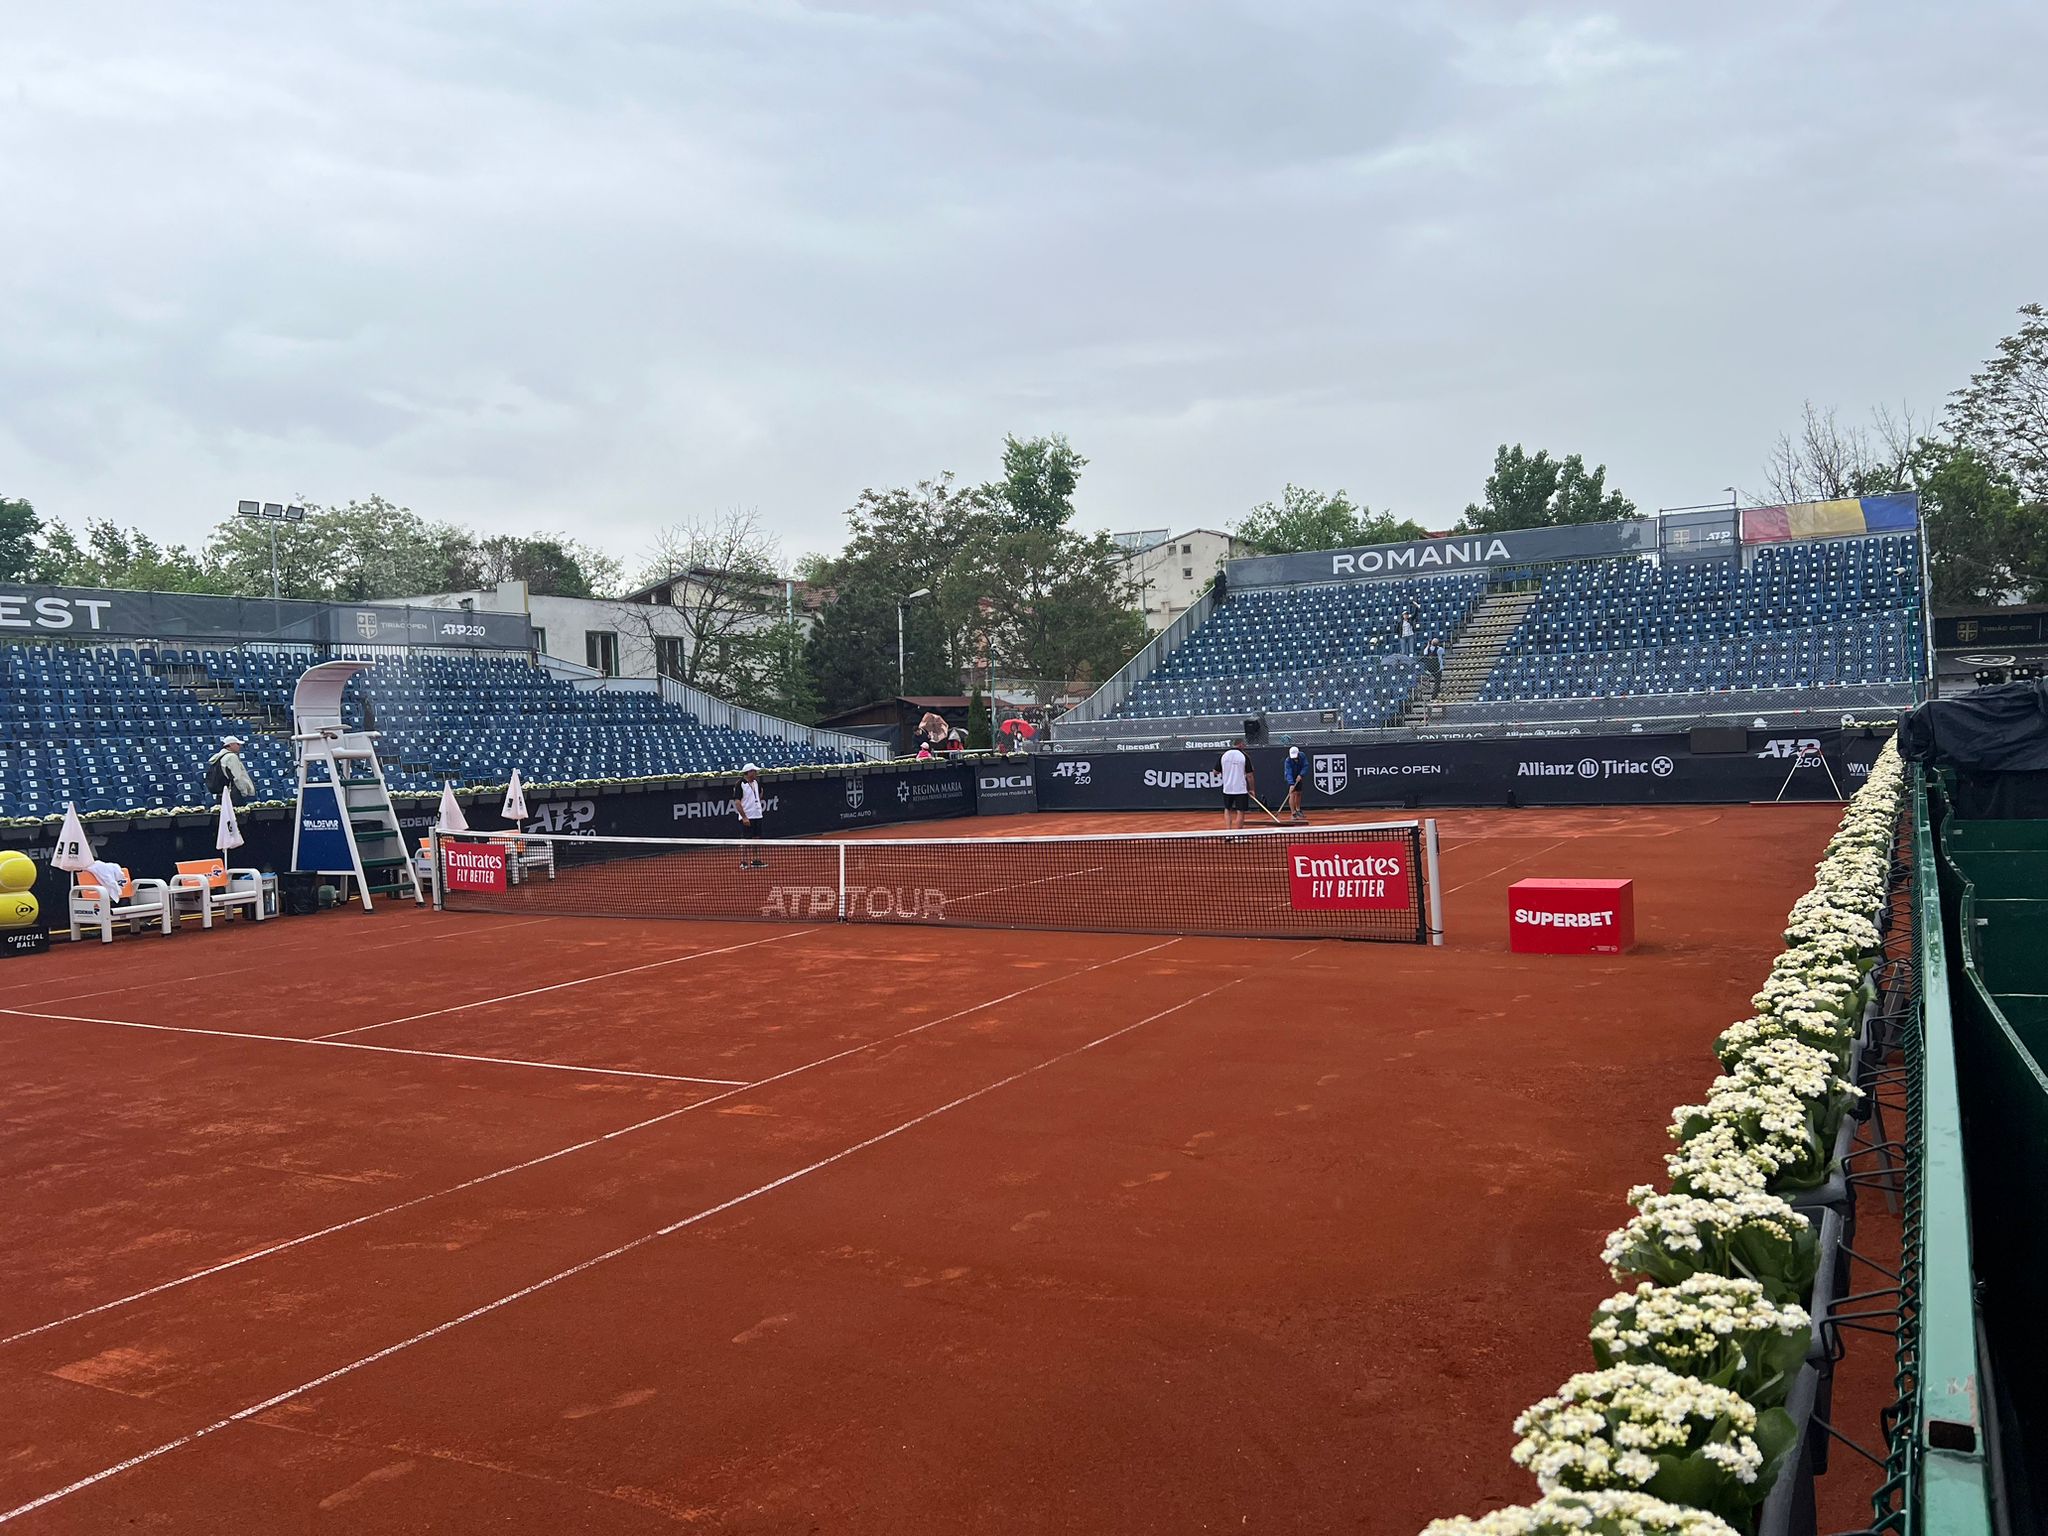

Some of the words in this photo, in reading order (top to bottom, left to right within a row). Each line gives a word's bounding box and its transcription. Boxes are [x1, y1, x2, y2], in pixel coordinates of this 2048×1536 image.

[1333, 539, 1511, 575] ROMANIA
[0, 595, 111, 630] EST
[381, 622, 406, 630] TIRIAC
[1754, 739, 1822, 759] ATP
[1052, 762, 1091, 777] ATP
[1517, 761, 1574, 776] Allianz
[1796, 757, 1822, 768] 250
[1354, 766, 1399, 777] TIRIAC
[1401, 765, 1441, 774] OPEN
[980, 776, 1032, 789] DIGI
[1075, 776, 1092, 785] 250
[912, 784, 940, 796] REGINA
[526, 800, 595, 833] ATP
[673, 799, 738, 820] PRIMA
[448, 850, 502, 869] Emirates
[1294, 854, 1400, 877] Emirates
[456, 869, 468, 882] FLY
[470, 870, 495, 884] BETTER
[1312, 880, 1333, 898] FLY
[1338, 879, 1385, 898] BETTER
[845, 886, 945, 920] TOUR
[1515, 908, 1613, 927] SUPERBET
[8, 933, 44, 943] OFFICIAL
[16, 941, 36, 949] BALL
